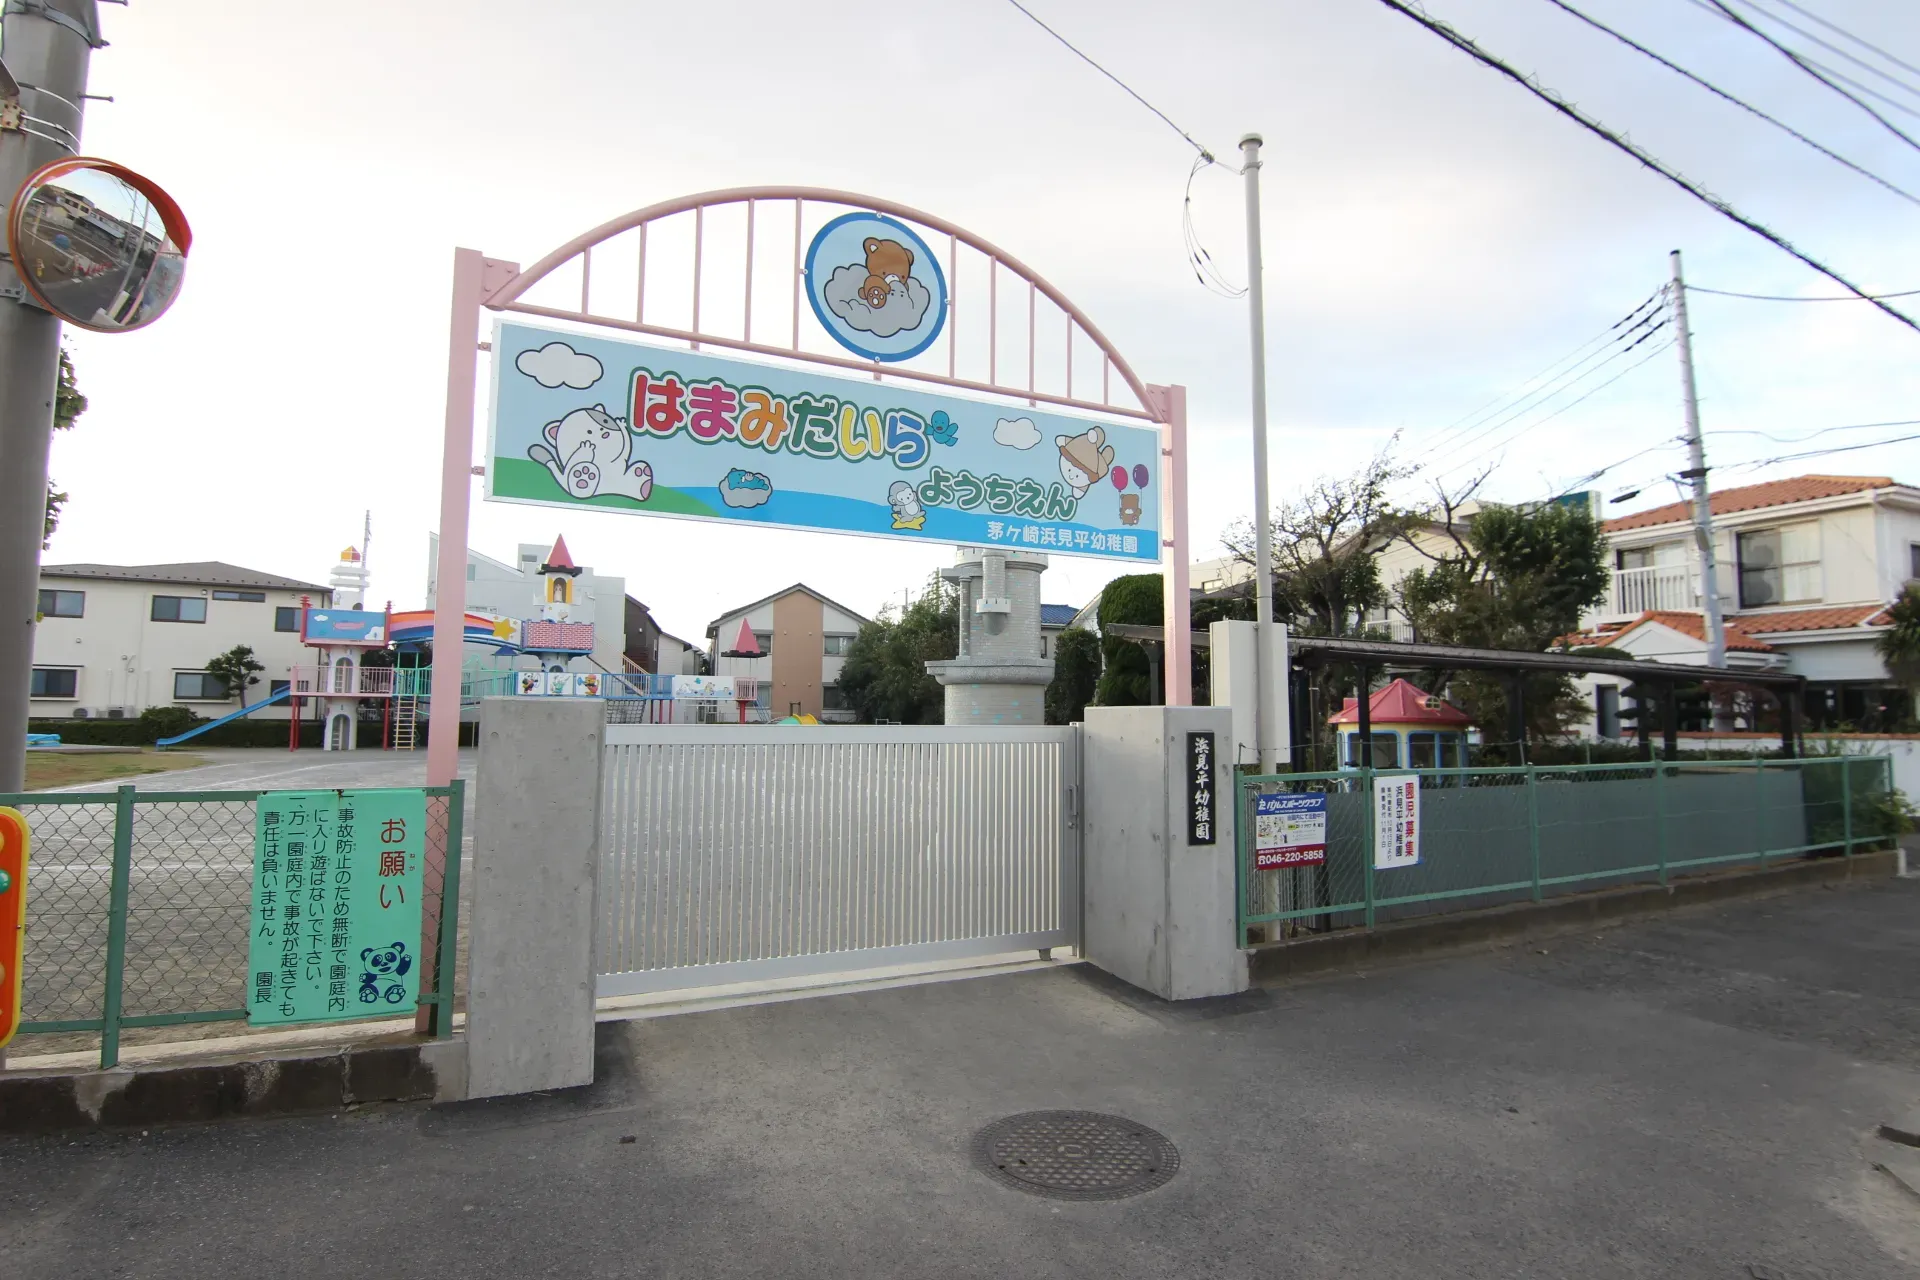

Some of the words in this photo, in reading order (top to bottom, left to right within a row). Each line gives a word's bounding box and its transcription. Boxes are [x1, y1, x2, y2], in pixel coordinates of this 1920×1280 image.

[627, 368, 931, 466] はまみだいら
[918, 467, 1080, 521] ようちえん
[1194, 737, 1210, 840] 浜見平幼稚園
[259, 811, 281, 947] 責任は負いません。
[306, 809, 329, 990] に入り遊ばないで下さい。
[328, 795, 355, 1013] 一、事故防止のため無断で園庭内
[379, 818, 406, 909] お願い
[1266, 850, 1324, 864] 046-220-5858
[278, 798, 306, 1017] 一、万一園庭内で事故が起きても
[255, 971, 273, 1004] 園長
